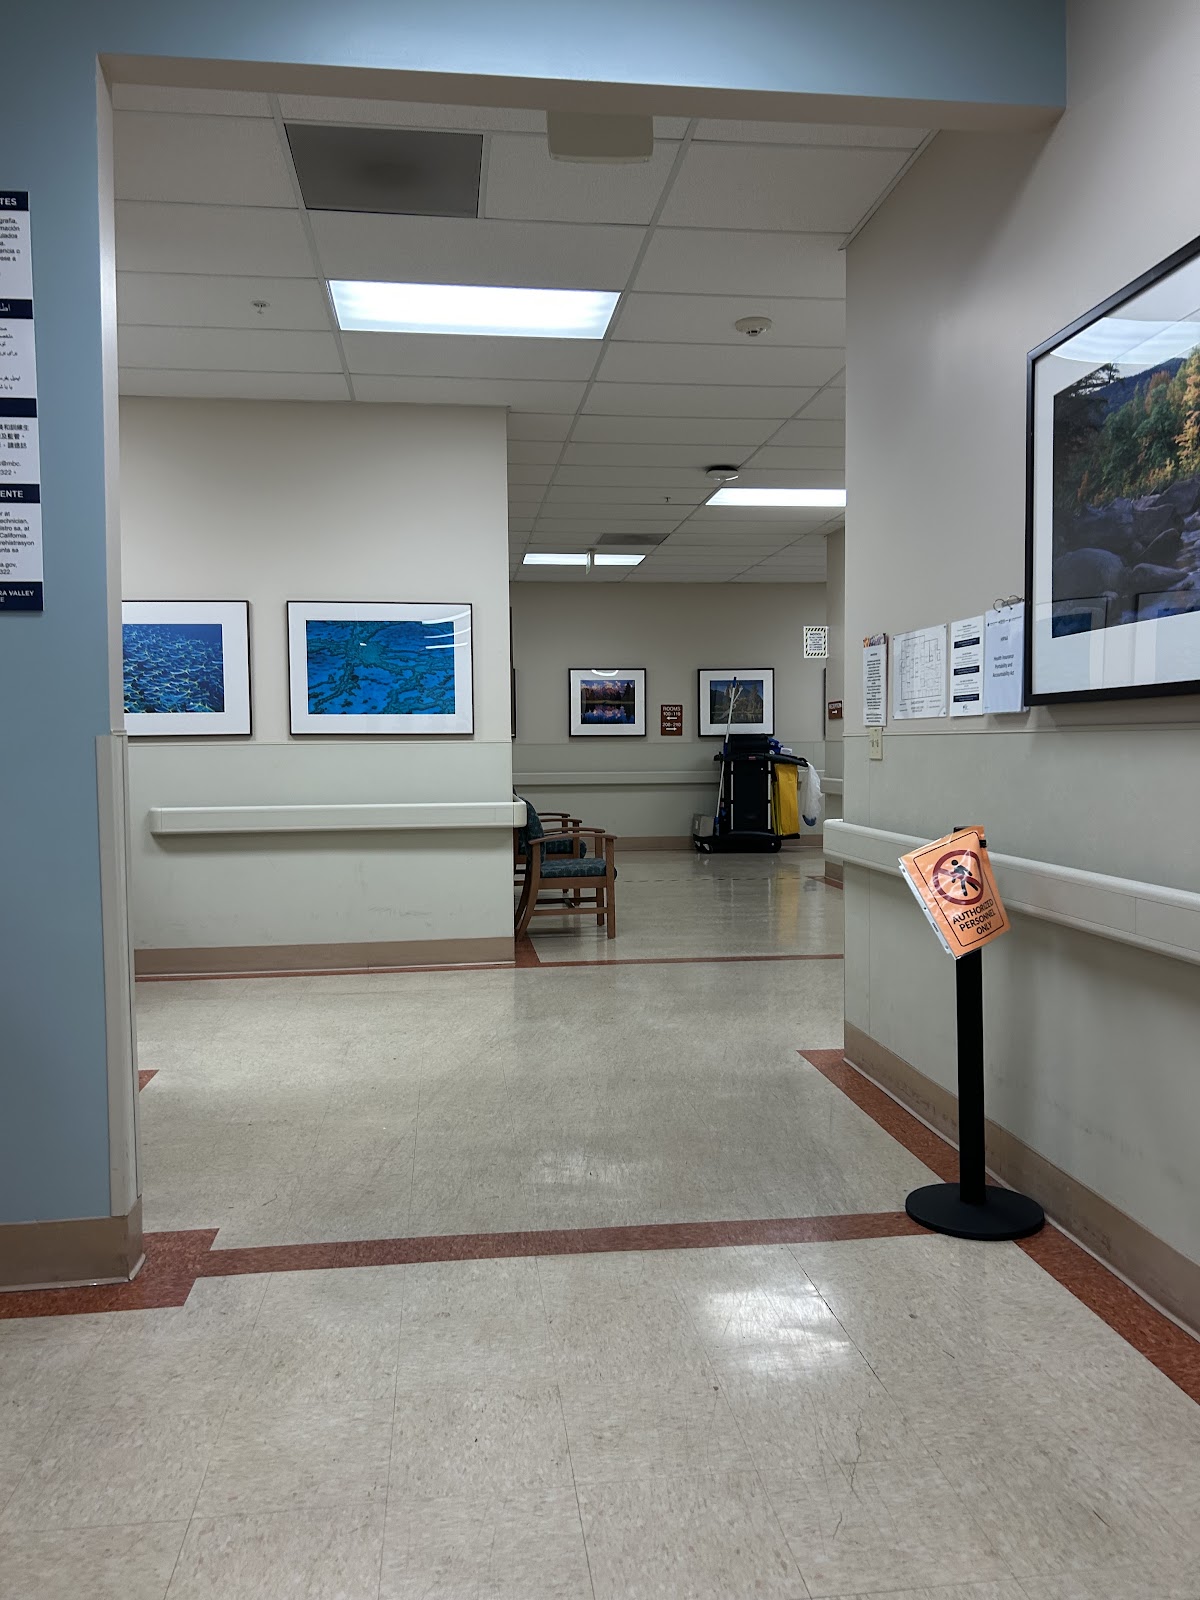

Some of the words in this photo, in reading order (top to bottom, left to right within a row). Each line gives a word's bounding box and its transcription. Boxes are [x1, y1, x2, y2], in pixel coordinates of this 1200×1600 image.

[952, 899, 994, 925] AUTHORIZED
[958, 909, 996, 932] PERSONNEL
[976, 922, 992, 935] ONLY
